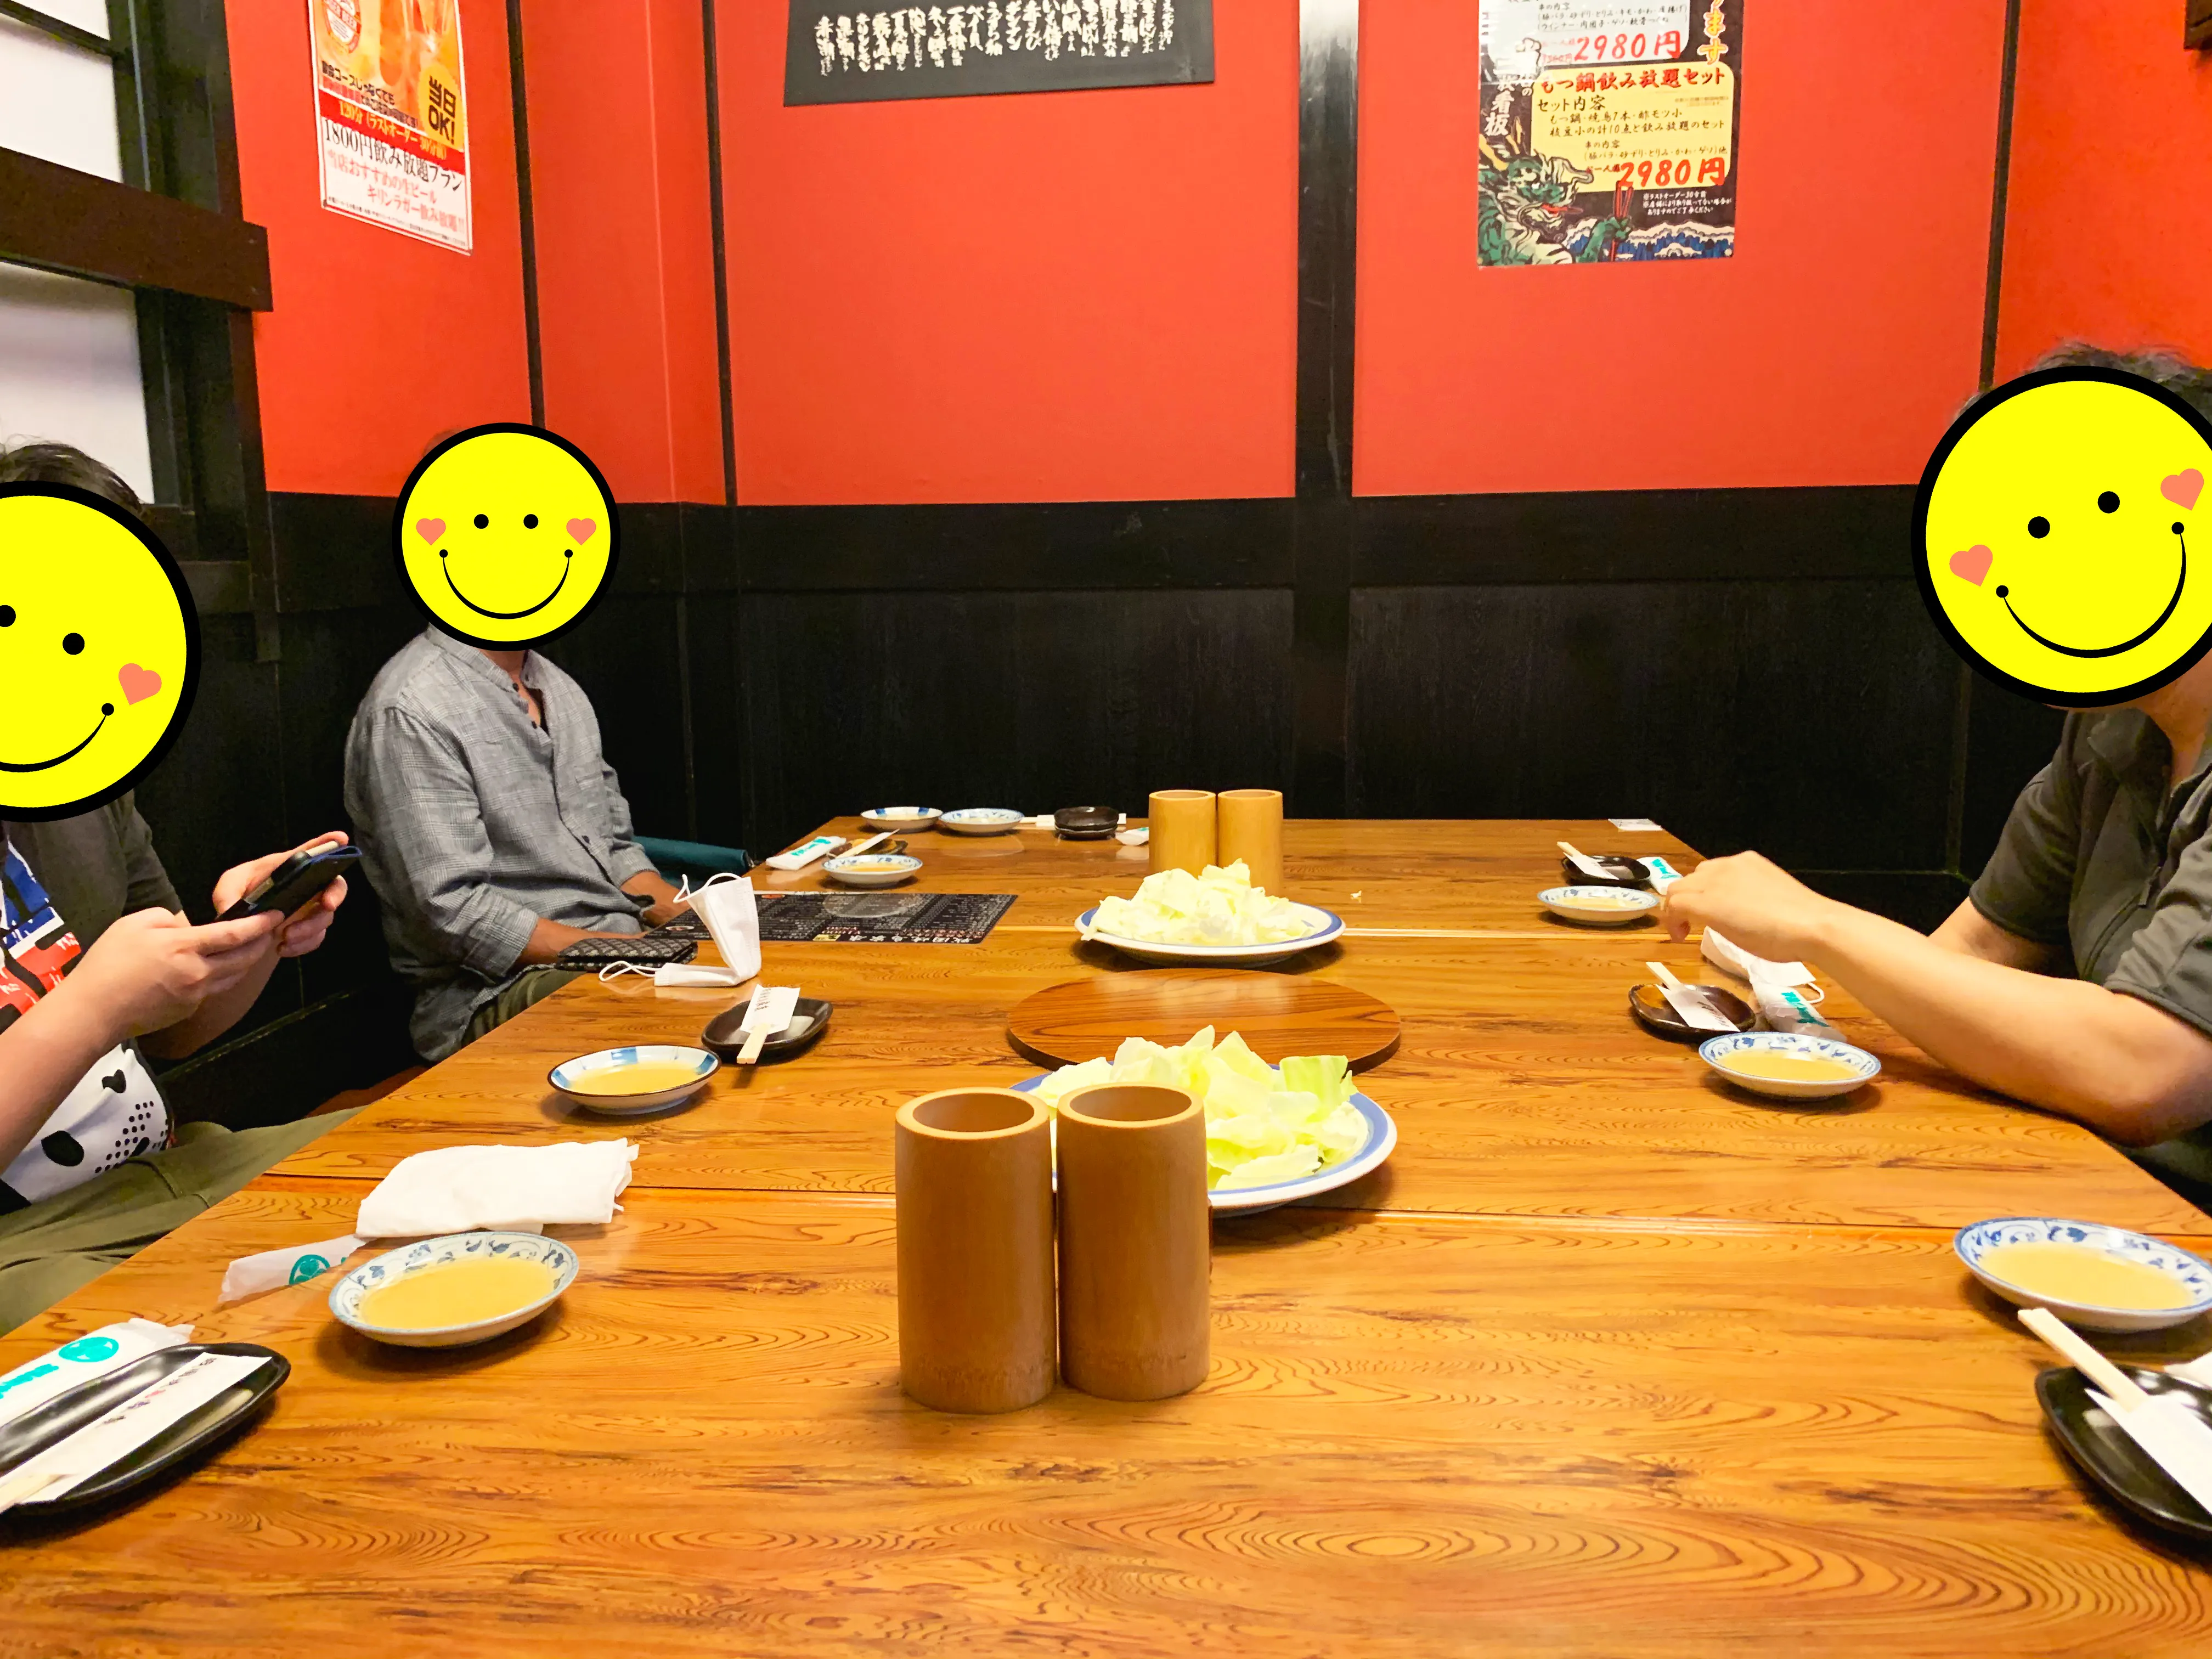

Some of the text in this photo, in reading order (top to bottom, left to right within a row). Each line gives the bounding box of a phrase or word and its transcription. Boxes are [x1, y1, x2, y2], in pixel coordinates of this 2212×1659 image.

[1574, 30, 1681, 62] 2980円
[1541, 67, 1725, 93] もつ鍋飲み放題セット
[428, 75, 456, 119] 当日
[1537, 94, 1606, 112] セット内容
[428, 105, 455, 144] OK!
[1550, 120, 1725, 138] 枝豆小の計10点と飲み放題のセット
[1585, 139, 1620, 150] 串の内容
[1617, 157, 1725, 187] 2980円
